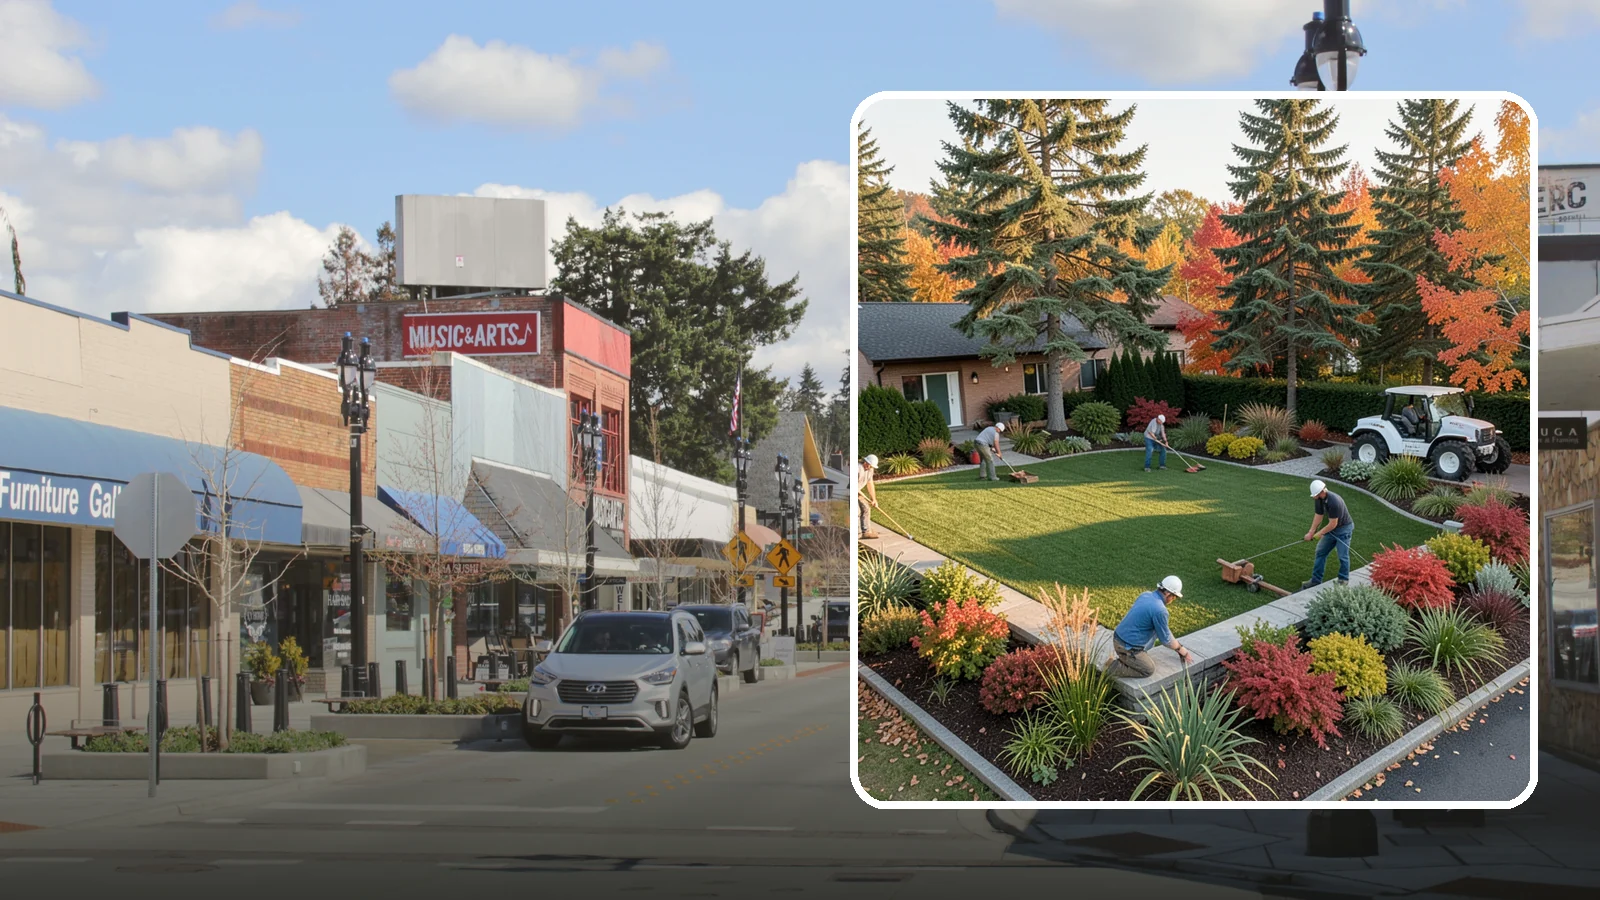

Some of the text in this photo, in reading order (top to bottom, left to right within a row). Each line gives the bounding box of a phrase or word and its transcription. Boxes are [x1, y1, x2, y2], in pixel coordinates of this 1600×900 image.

[409, 323, 519, 349] MUSIC&ARTS
[0, 471, 121, 519] Furniture Gal
[453, 562, 479, 574] SUSHI
